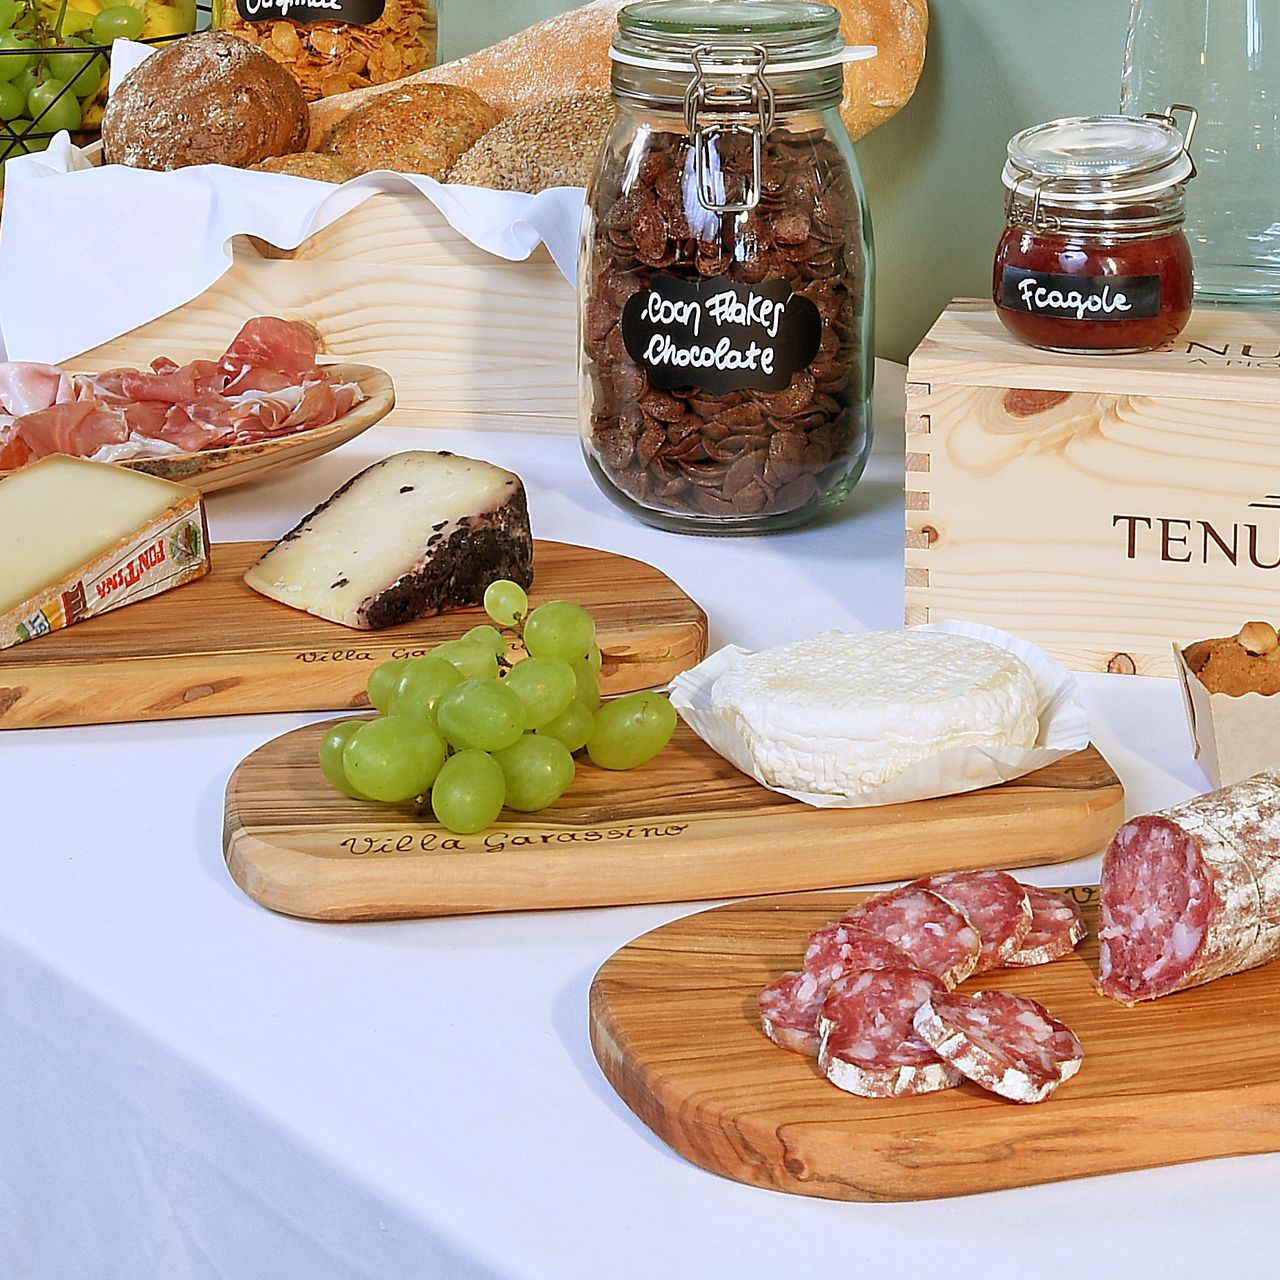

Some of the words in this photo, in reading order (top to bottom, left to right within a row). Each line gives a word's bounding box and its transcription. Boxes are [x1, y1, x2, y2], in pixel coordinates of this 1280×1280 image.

[705, 290, 785, 337] Flakes
[1017, 277, 1132, 319] Fragole
[643, 333, 774, 375] Chocolate
[296, 650, 376, 663] Villa
[340, 832, 465, 855] Villa
[483, 822, 690, 853] Garassino
